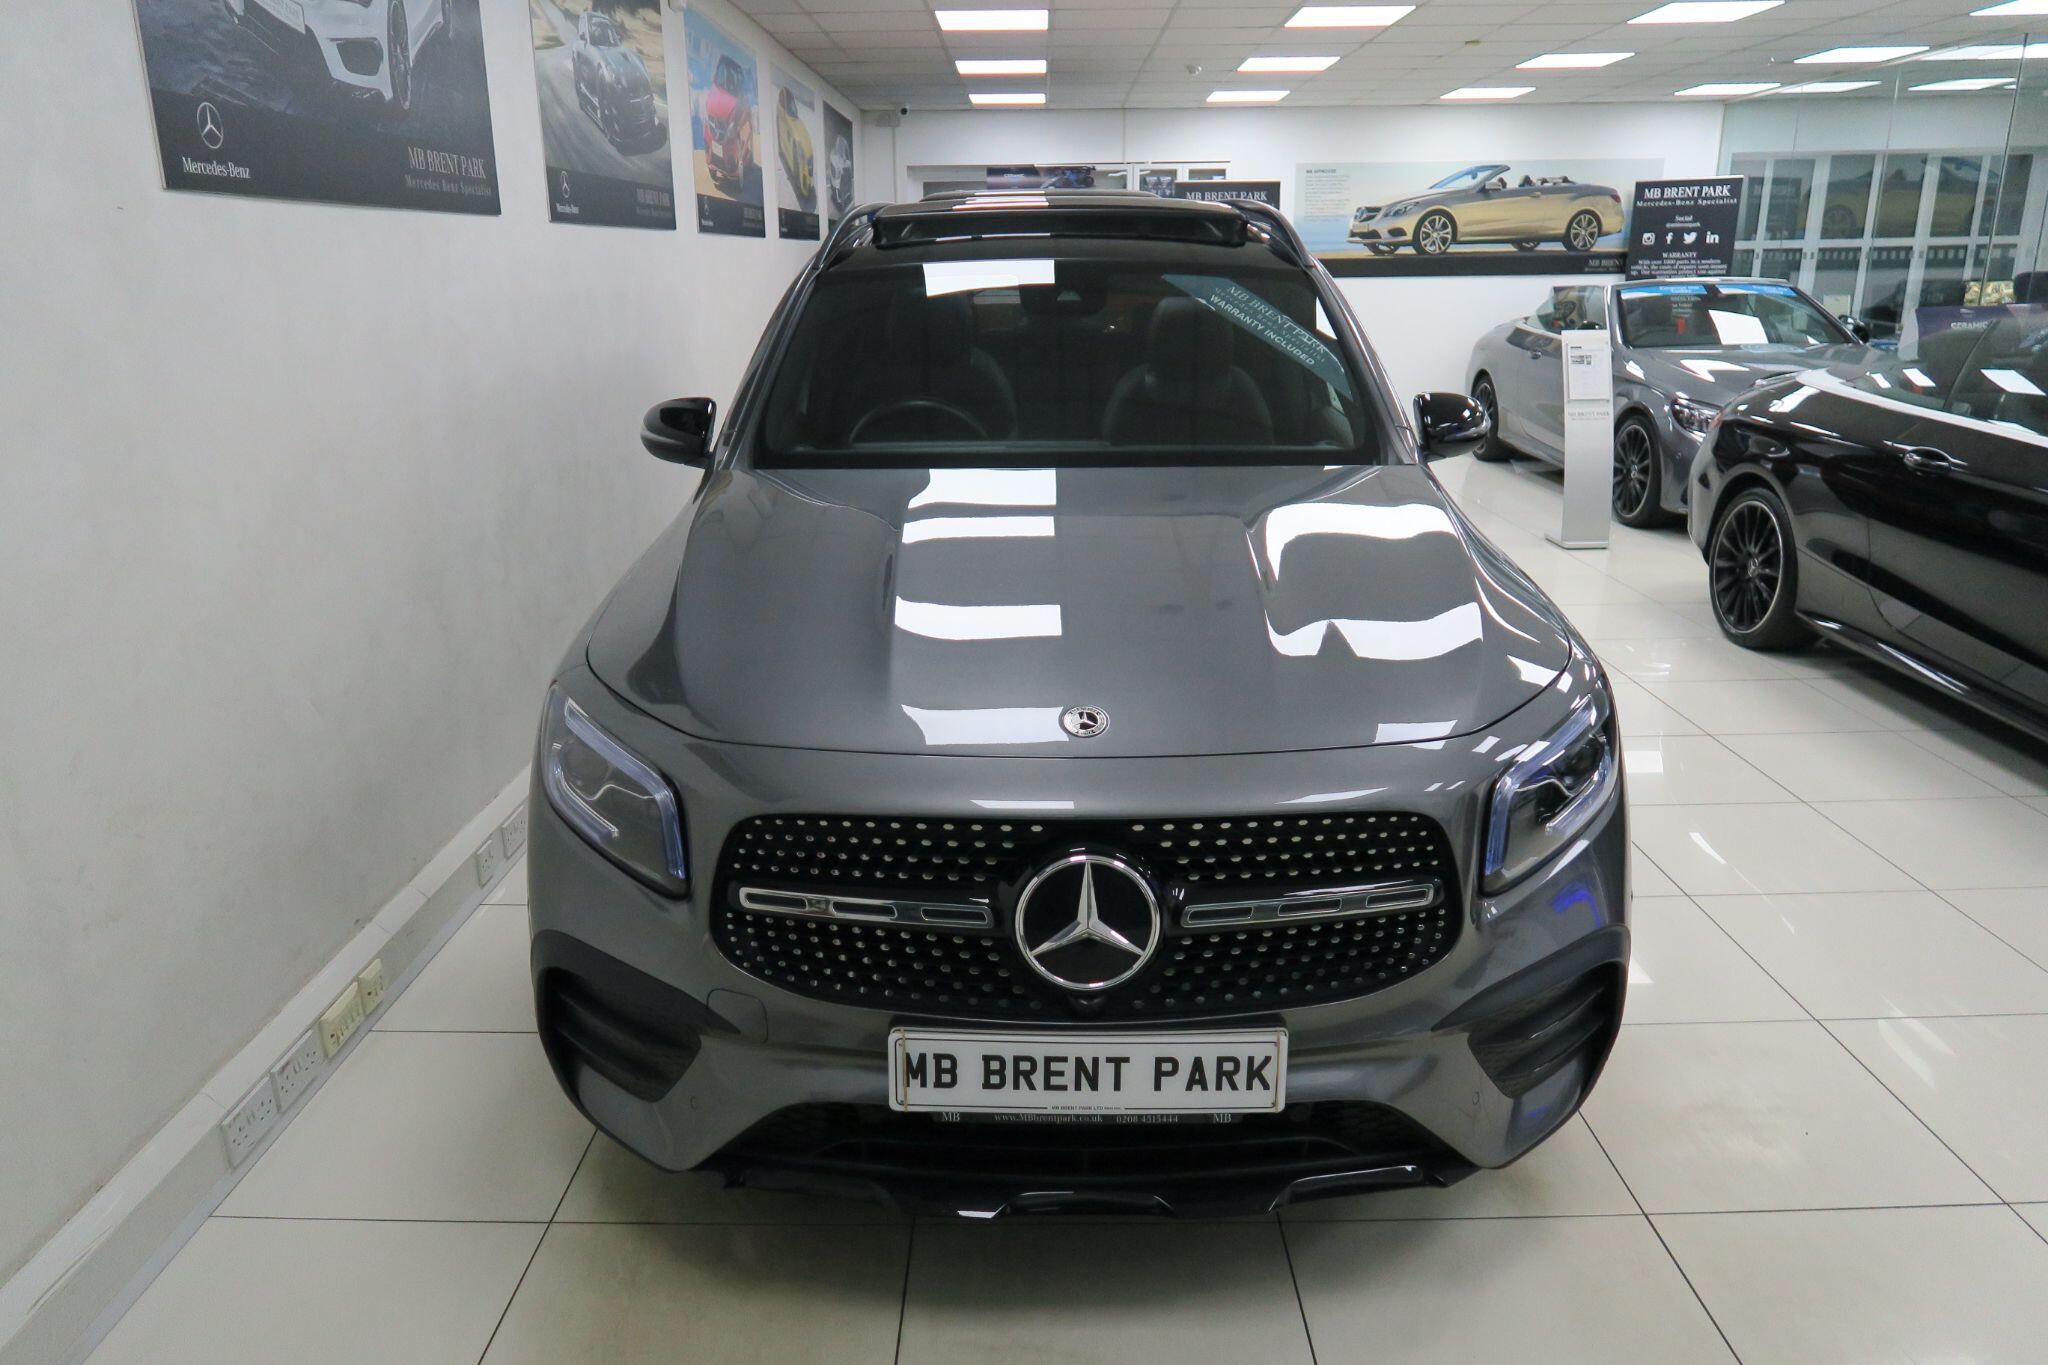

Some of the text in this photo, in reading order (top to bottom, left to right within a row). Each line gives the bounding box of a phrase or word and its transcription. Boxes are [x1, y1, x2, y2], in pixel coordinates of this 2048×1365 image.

[182, 155, 251, 179] Mercedes-Benz
[408, 146, 486, 179] MB BRENT PARK
[1186, 191, 1268, 201] MB BRENT PARK
[1643, 184, 1731, 199] MB BRENT PARK
[1697, 198, 1738, 206] Specialist
[1662, 251, 1698, 259] WARRANTY
[1228, 286, 1250, 301] MB
[1250, 299, 1291, 328] BRENT
[1210, 294, 1316, 366] WARRANTY INCLUDED
[905, 1052, 1273, 1092] MB BRENT PARK
[942, 1111, 961, 1122] MB
[1116, 1114, 1139, 1124] 0208
[1212, 1112, 1233, 1124] MB
